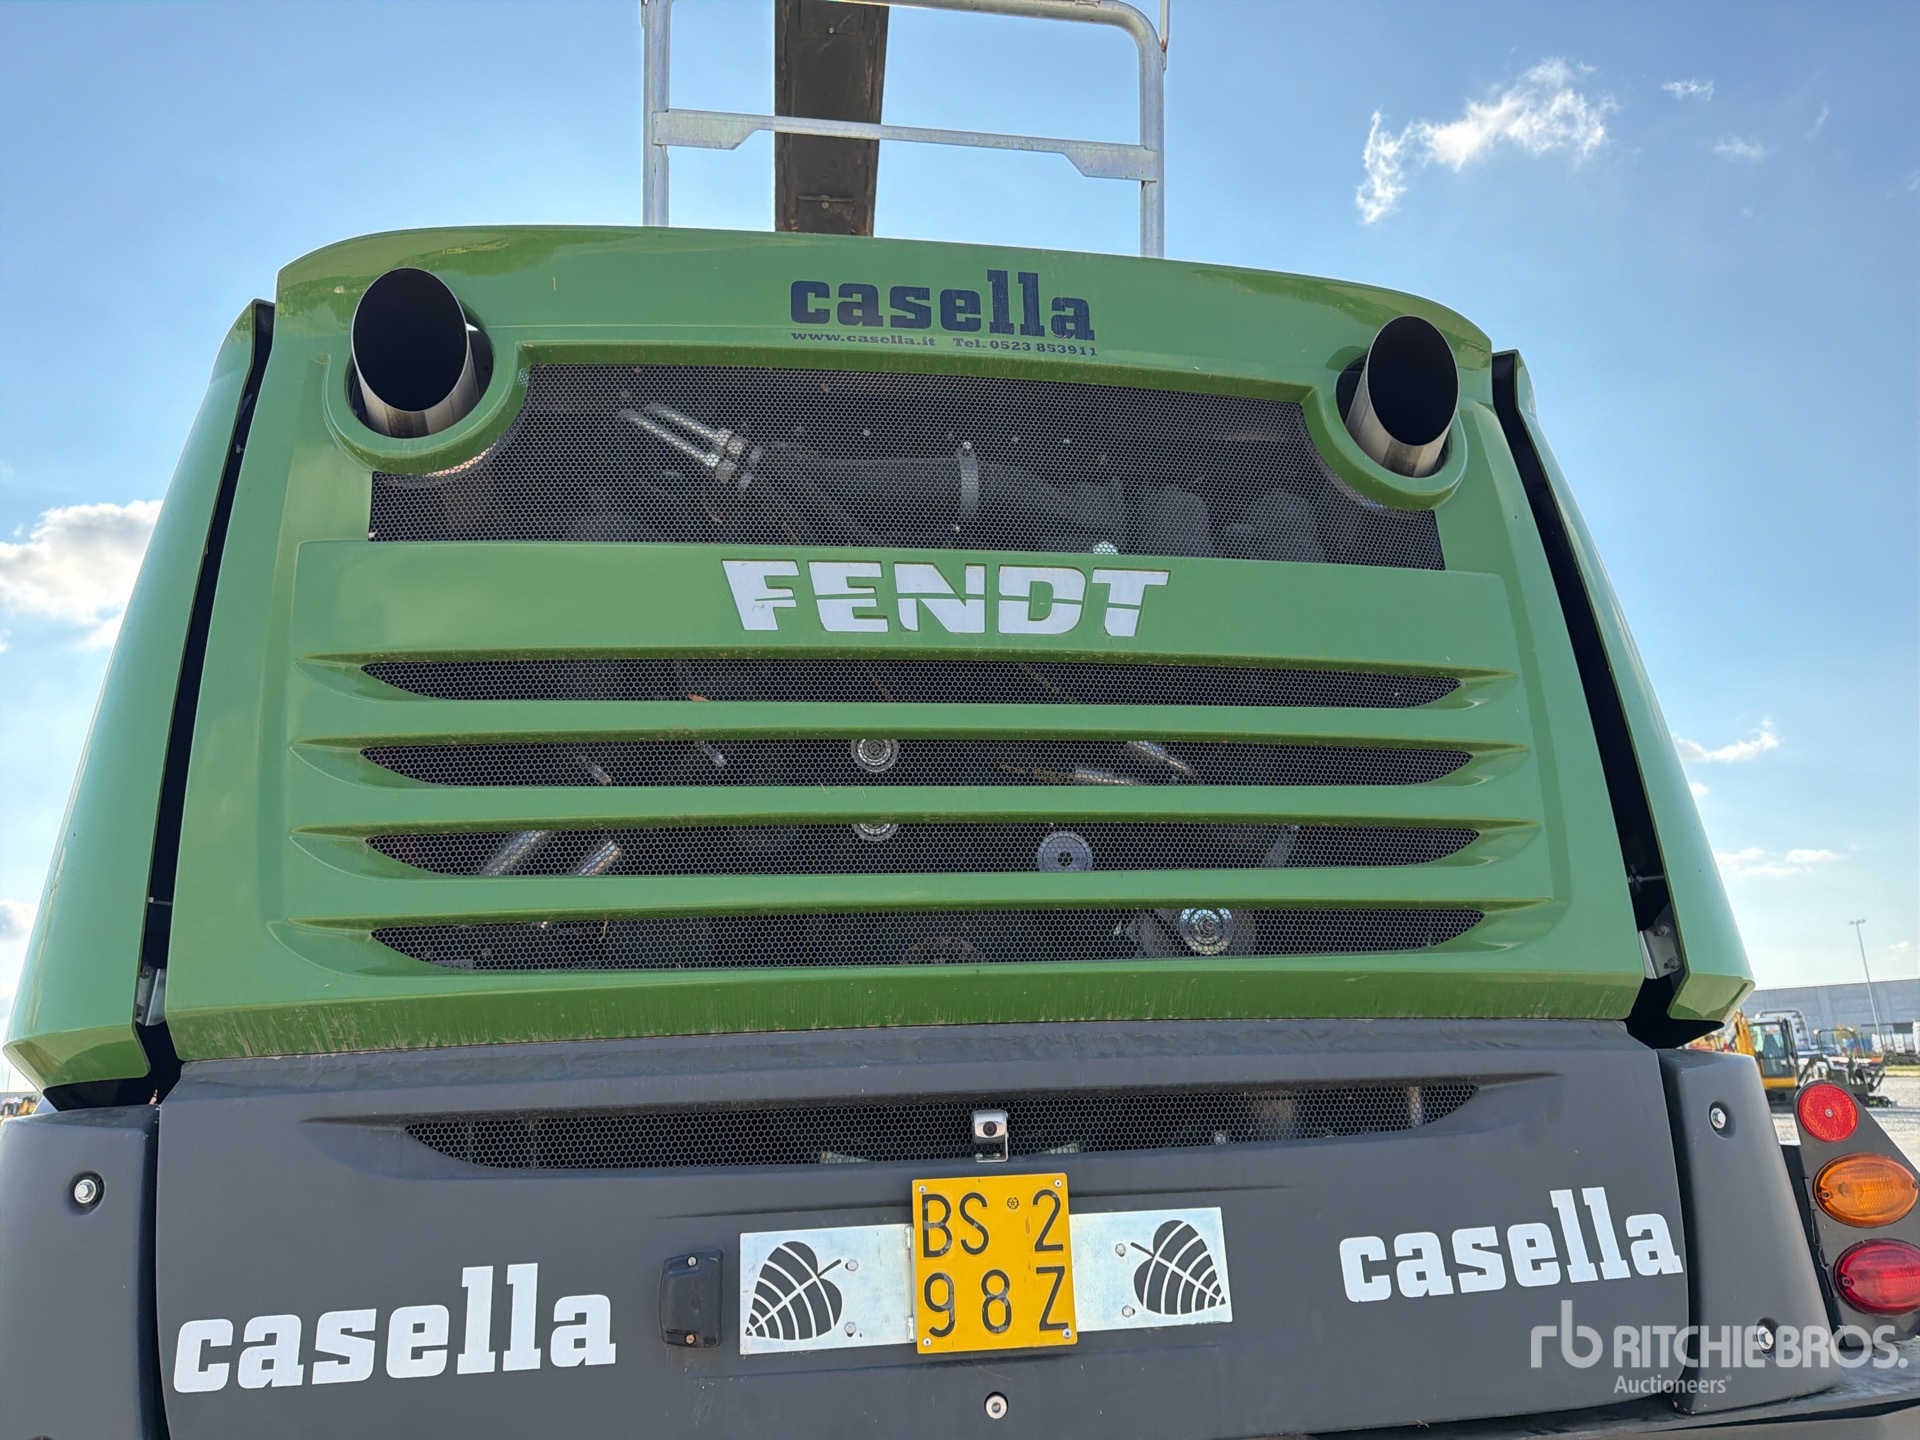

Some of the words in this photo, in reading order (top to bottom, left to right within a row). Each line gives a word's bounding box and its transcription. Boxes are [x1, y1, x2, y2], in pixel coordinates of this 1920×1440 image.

[790, 269, 1096, 341] casella
[790, 332, 937, 347] www.casella.it
[952, 337, 987, 349] Tel.
[989, 340, 1032, 352] 0523
[1036, 343, 1098, 357] 853911
[721, 559, 1171, 637] FENDT
[921, 1191, 990, 1259] BS
[1032, 1188, 1062, 1253] 2
[1339, 1186, 1684, 1303] casella
[173, 1262, 616, 1394] casella
